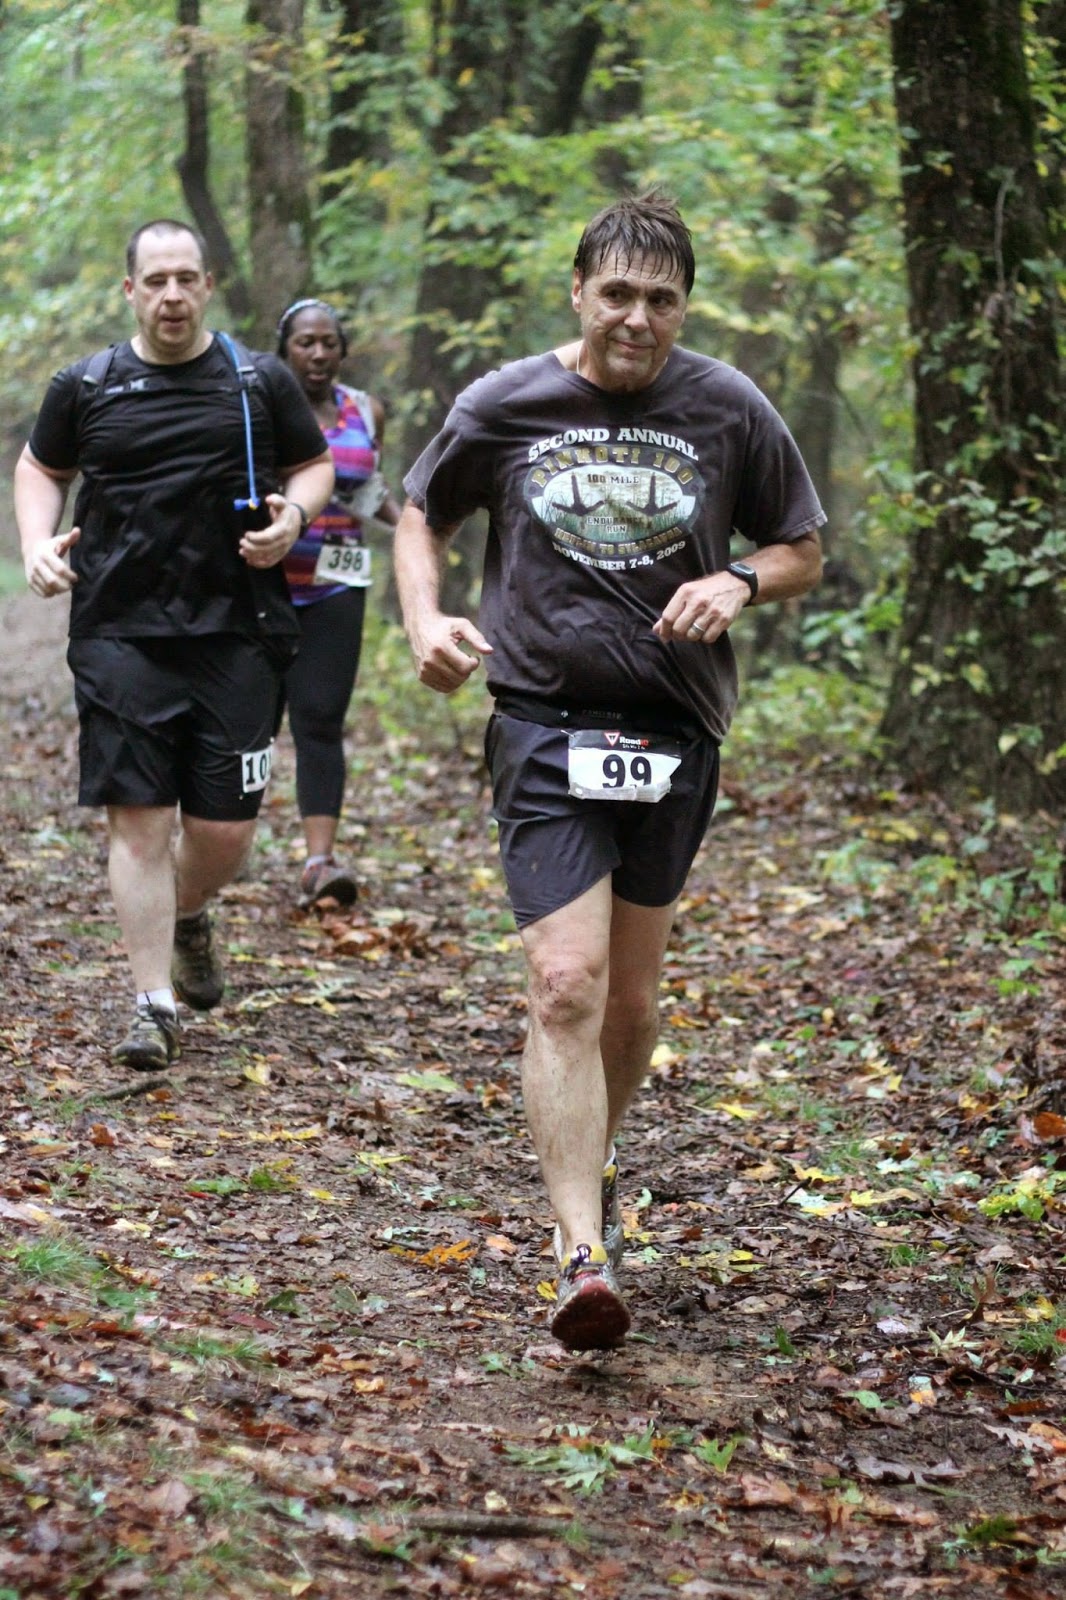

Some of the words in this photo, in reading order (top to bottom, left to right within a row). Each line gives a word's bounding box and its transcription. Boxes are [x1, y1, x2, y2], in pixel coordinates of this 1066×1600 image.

[528, 428, 610, 463] SECOND
[617, 428, 699, 461] ANNUAL
[532, 447, 641, 488] PINHOTI
[653, 451, 693, 485] 100
[588, 474, 606, 484] 100
[611, 476, 639, 484] MILE
[606, 525, 627, 534] RUN
[327, 549, 363, 572] 398
[553, 542, 626, 571] NOVEMBER
[656, 541, 686, 560] 2009
[246, 753, 271, 785] 10
[602, 754, 652, 789] 99
